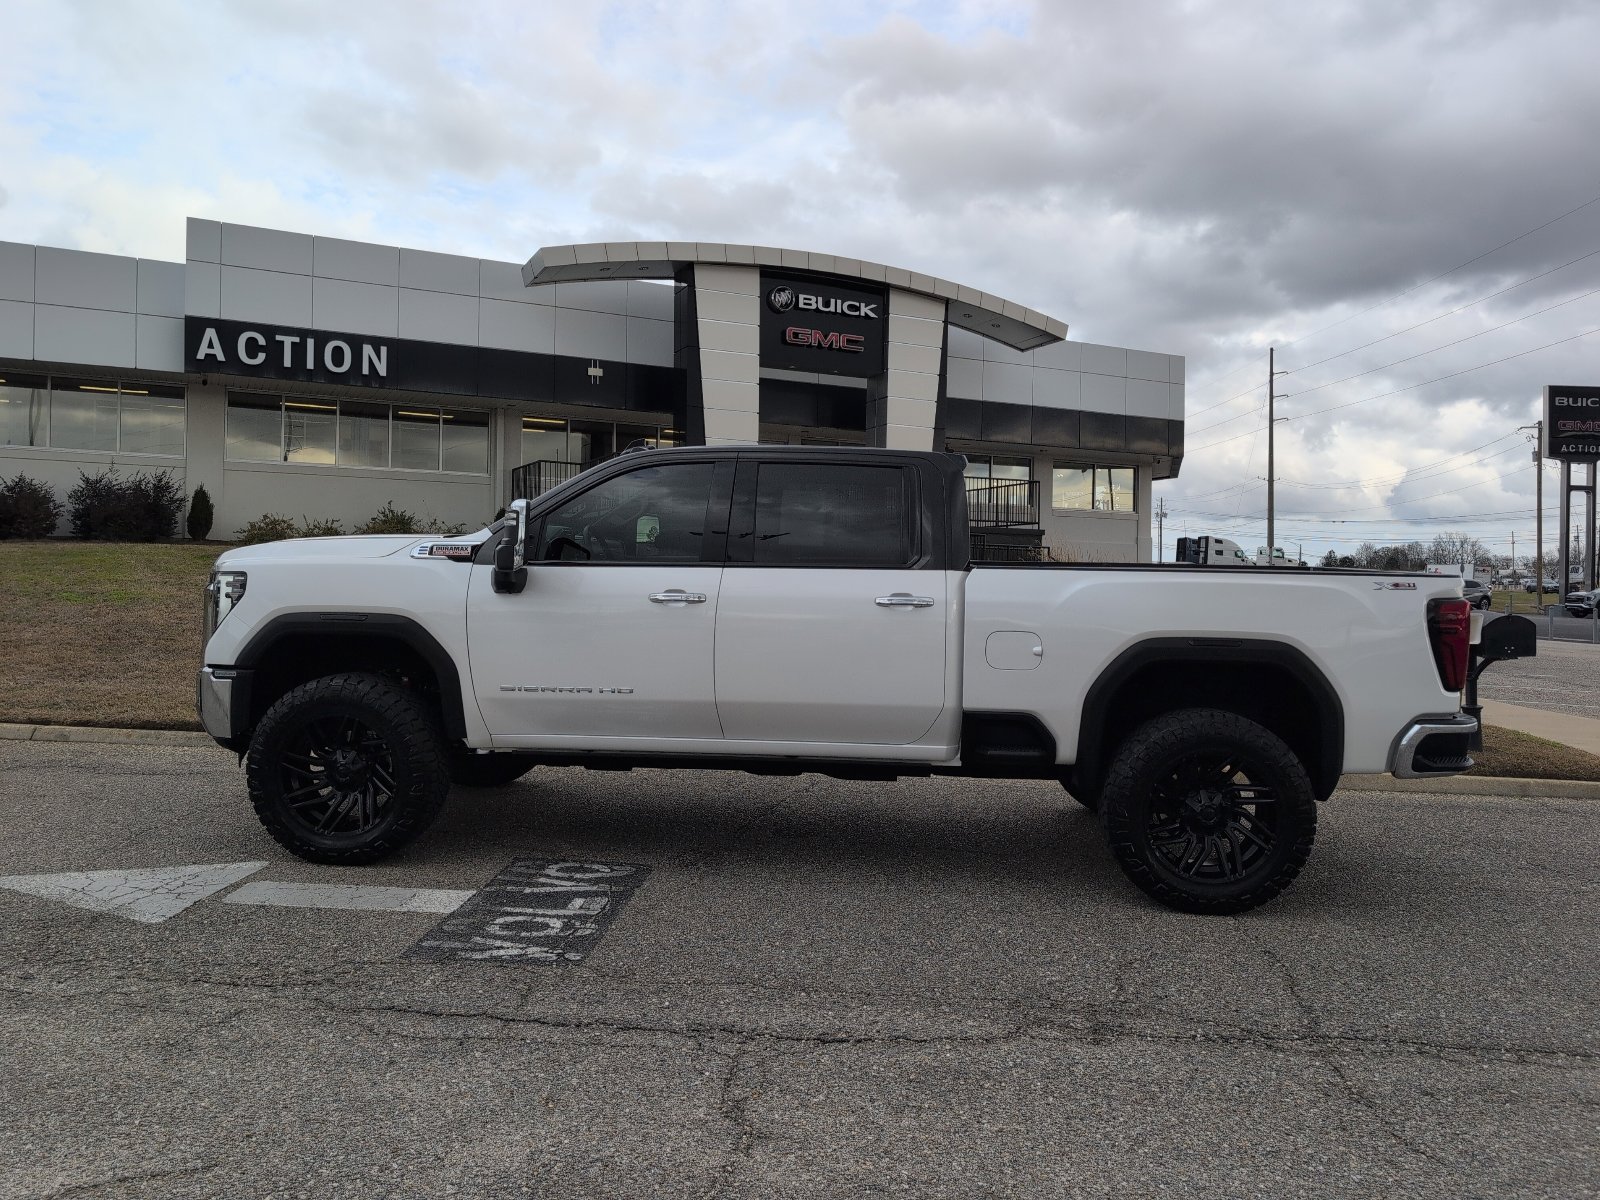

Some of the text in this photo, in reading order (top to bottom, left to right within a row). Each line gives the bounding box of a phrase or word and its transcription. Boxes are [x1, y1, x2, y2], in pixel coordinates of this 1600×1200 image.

[798, 293, 878, 318] BUICK
[786, 326, 864, 352] GMC
[196, 327, 388, 377] ACTION
[1555, 396, 1600, 407] BUIC
[1561, 444, 1600, 453] ACTIO
[500, 684, 592, 693] SIERRA
